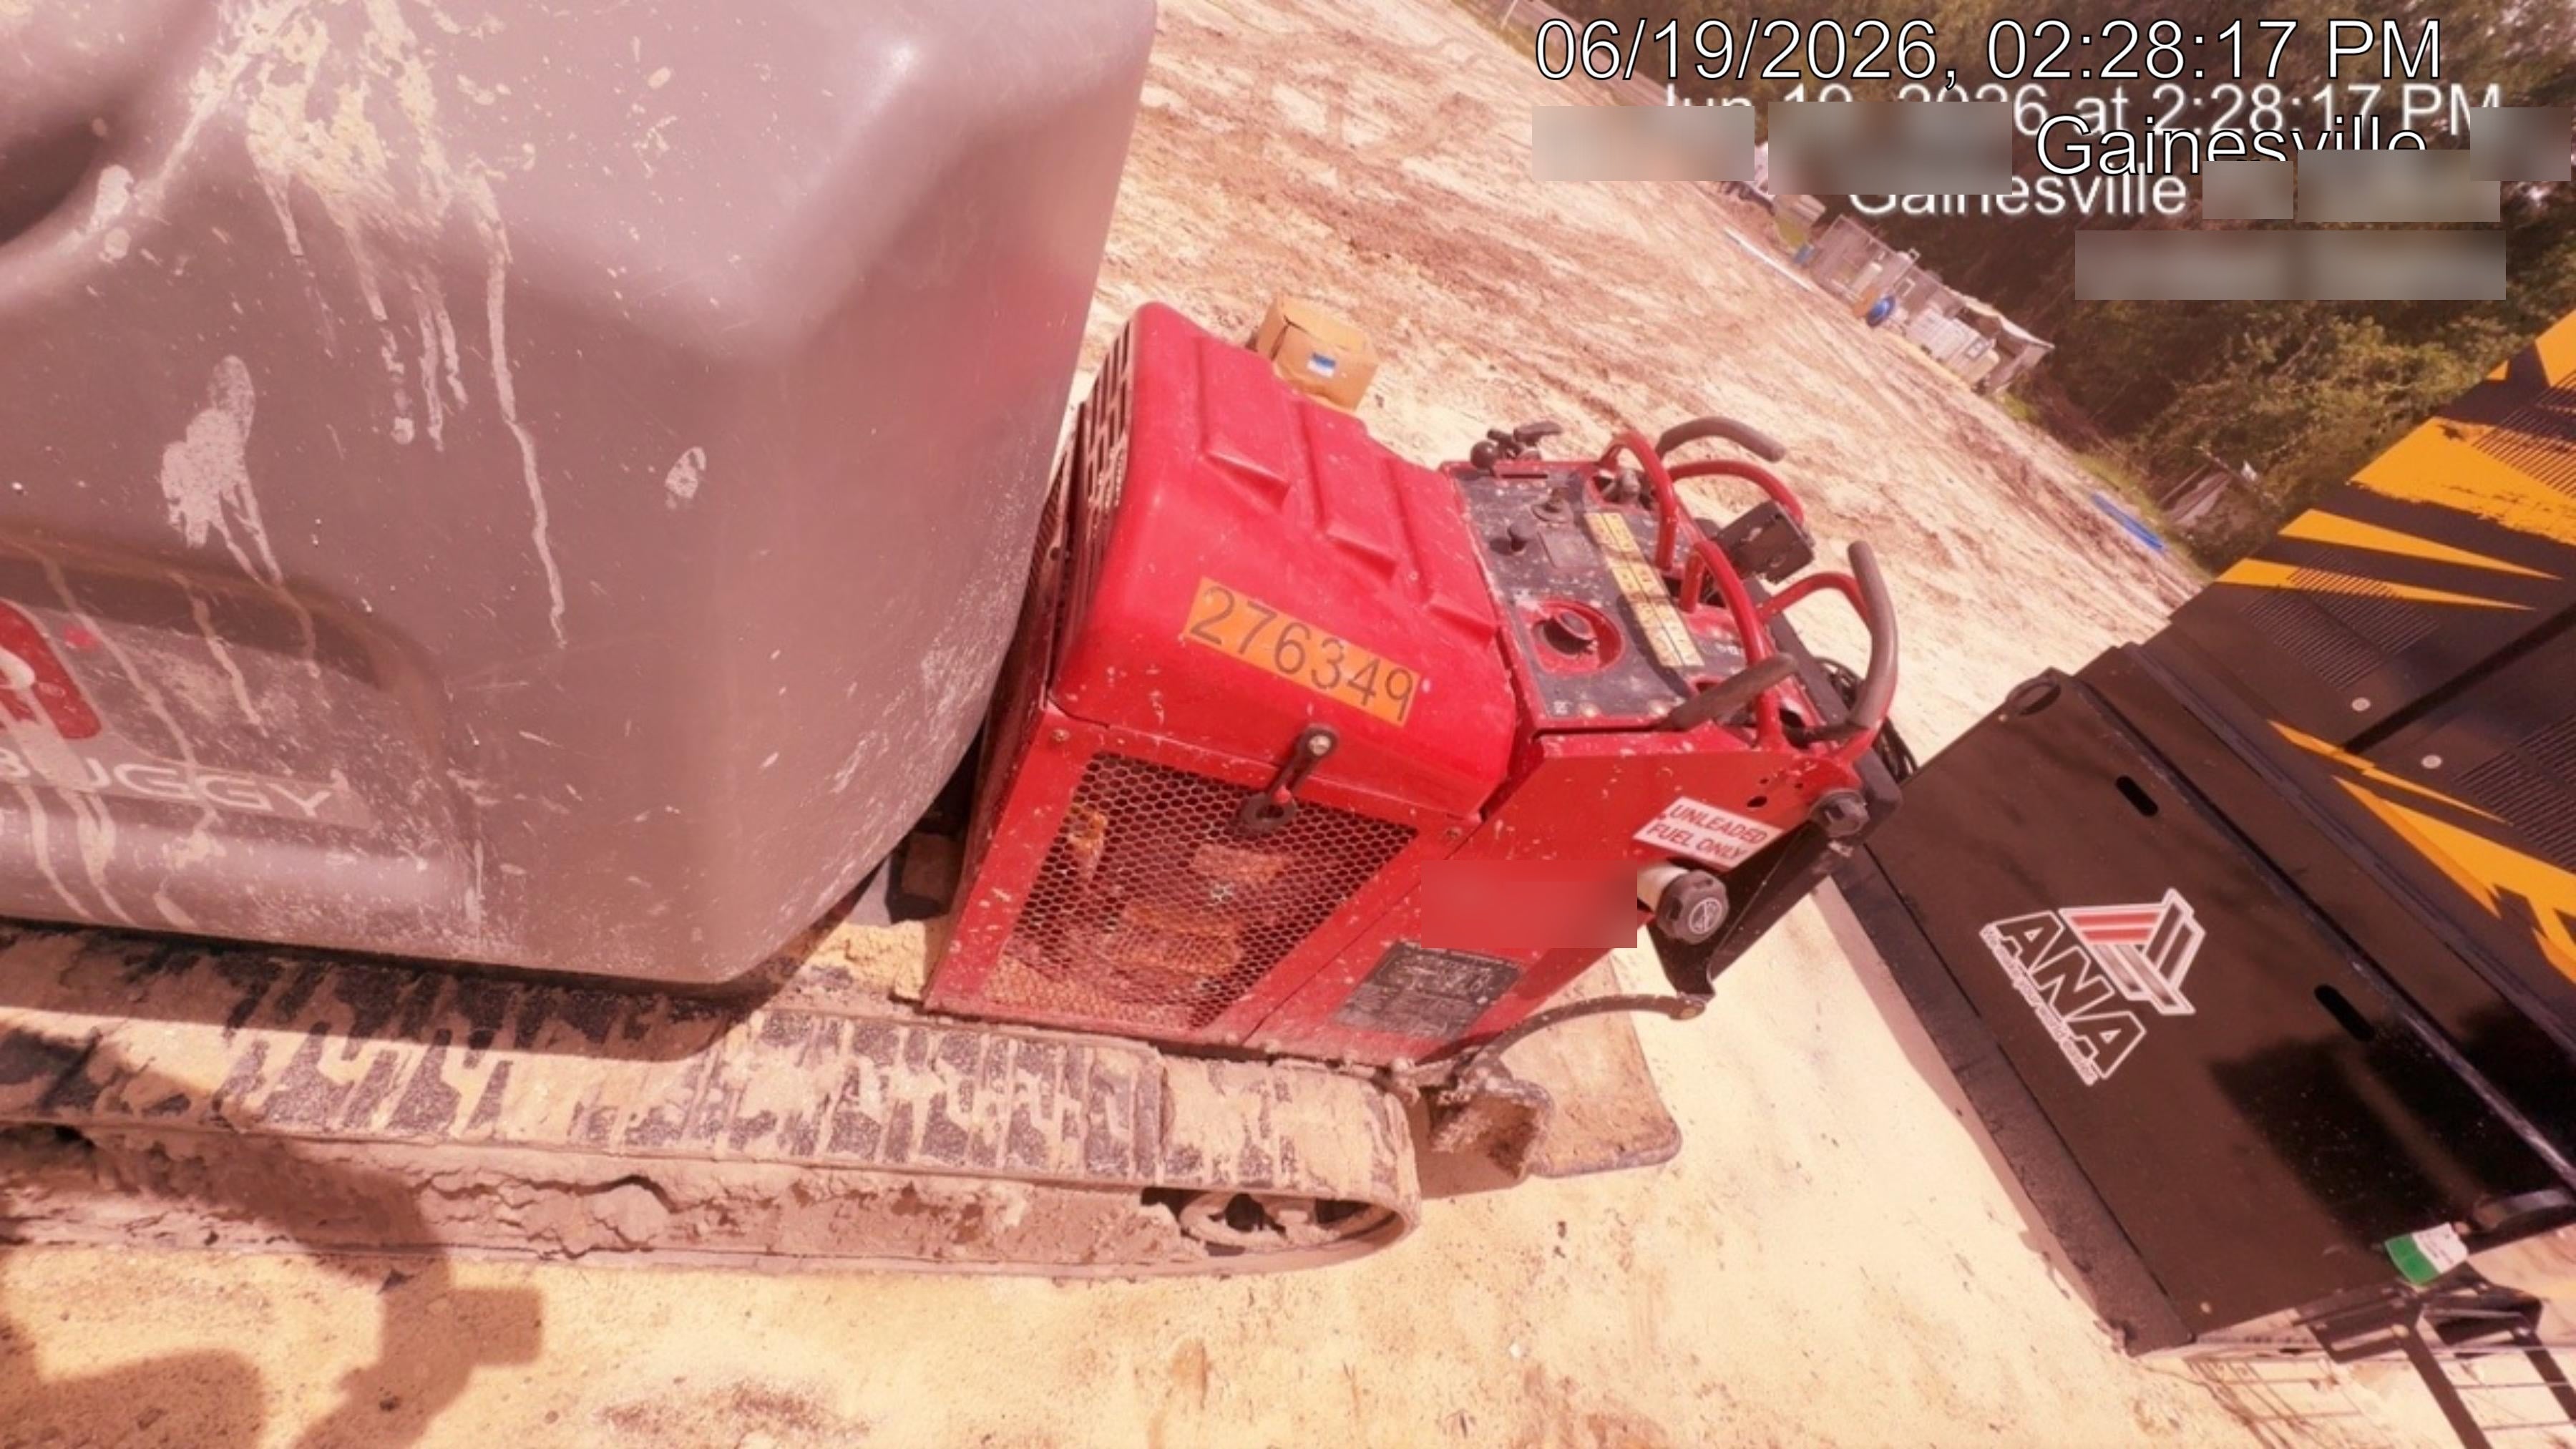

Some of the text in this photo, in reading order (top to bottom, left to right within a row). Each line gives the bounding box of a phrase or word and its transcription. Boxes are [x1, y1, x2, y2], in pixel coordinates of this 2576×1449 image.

[1189, 585, 1413, 722] 276349
[1646, 822, 1750, 859] FUEL ONLY
[1669, 804, 1768, 845] UNLEADED
[1992, 909, 2147, 1080] ANA
